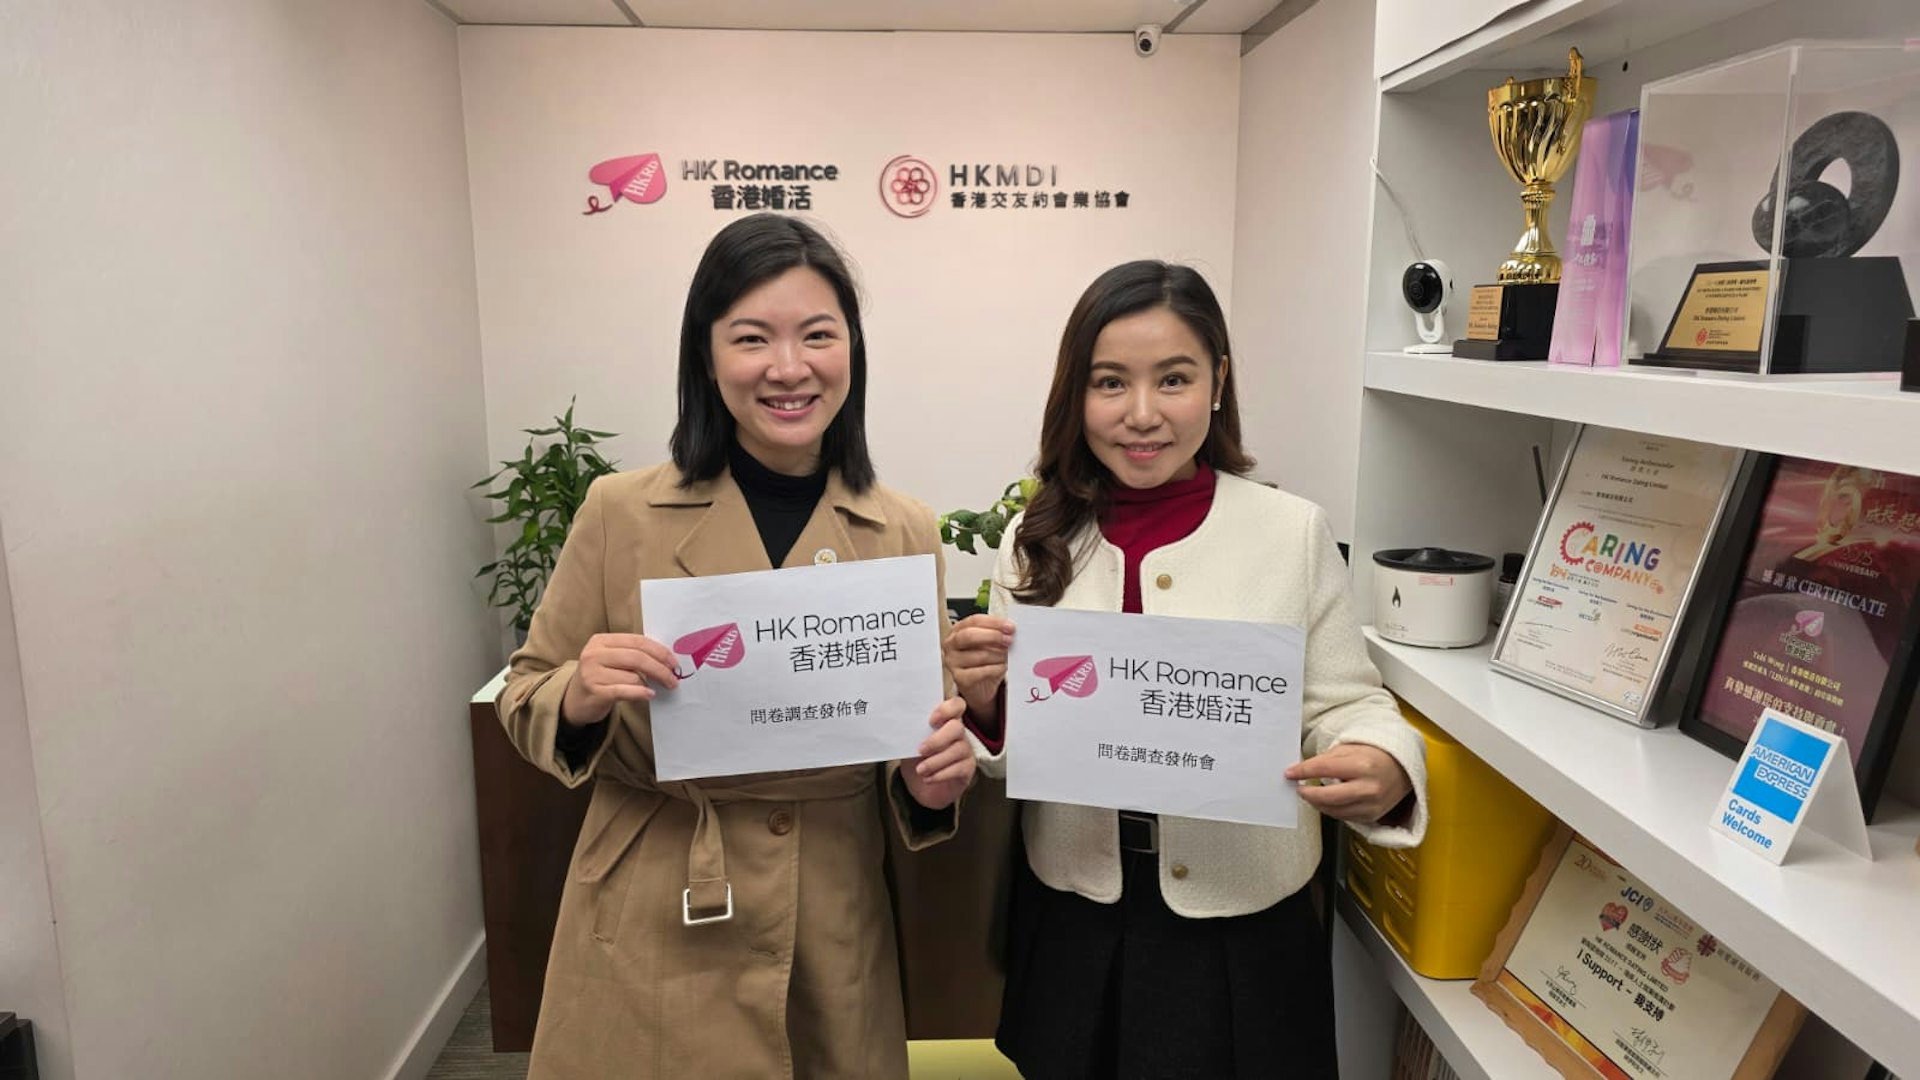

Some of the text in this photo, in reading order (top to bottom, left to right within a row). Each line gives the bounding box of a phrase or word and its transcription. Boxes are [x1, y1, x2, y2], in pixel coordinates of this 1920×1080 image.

[681, 160, 838, 181] HK Romance
[949, 164, 1057, 187] HKMDI
[711, 185, 811, 210] 香港婚活
[1560, 521, 1661, 571] CARING
[1585, 559, 1652, 585] COMPANY
[1798, 579, 1887, 617] CERTIFICATE
[755, 608, 926, 642] HK Romance
[789, 635, 898, 673] 香港婚活
[1109, 657, 1288, 695] HK Romance
[750, 699, 869, 725] 問卷調查發佈會
[1140, 689, 1253, 725] 香港婚活
[1098, 743, 1216, 771] 問卷調查發佈會
[1752, 746, 1813, 781] AMERICAN
[1756, 765, 1810, 799] EXPRESS
[1728, 799, 1762, 825] Cards
[1721, 812, 1773, 849] Welcome
[1621, 886, 1644, 907] JCI
[1626, 922, 1664, 955] 感謝狀
[1581, 953, 1623, 991] Support
